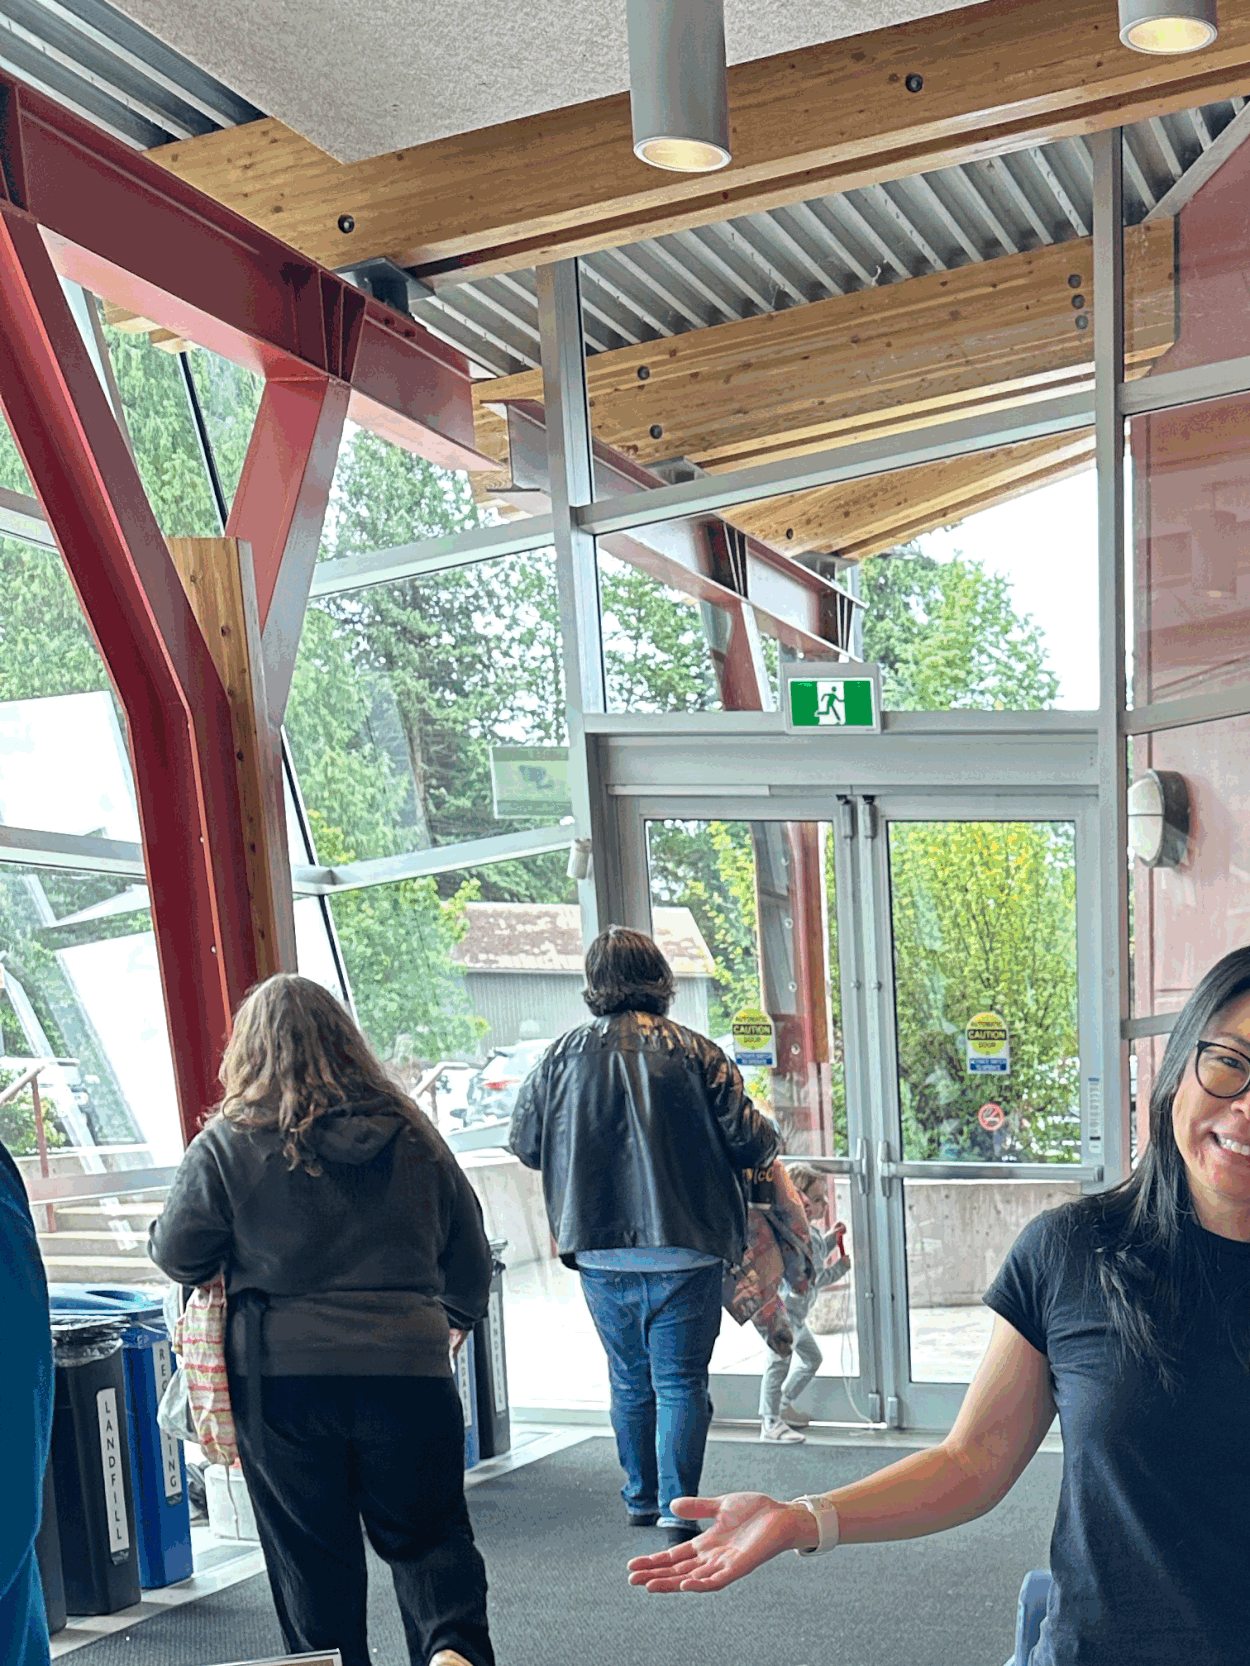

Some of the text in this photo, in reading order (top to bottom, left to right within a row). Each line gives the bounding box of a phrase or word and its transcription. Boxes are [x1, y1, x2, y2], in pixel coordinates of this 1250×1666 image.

[733, 1025, 770, 1035] CAUTION
[968, 1030, 1005, 1040] CAUTION
[105, 1401, 122, 1540] LANDFILL
